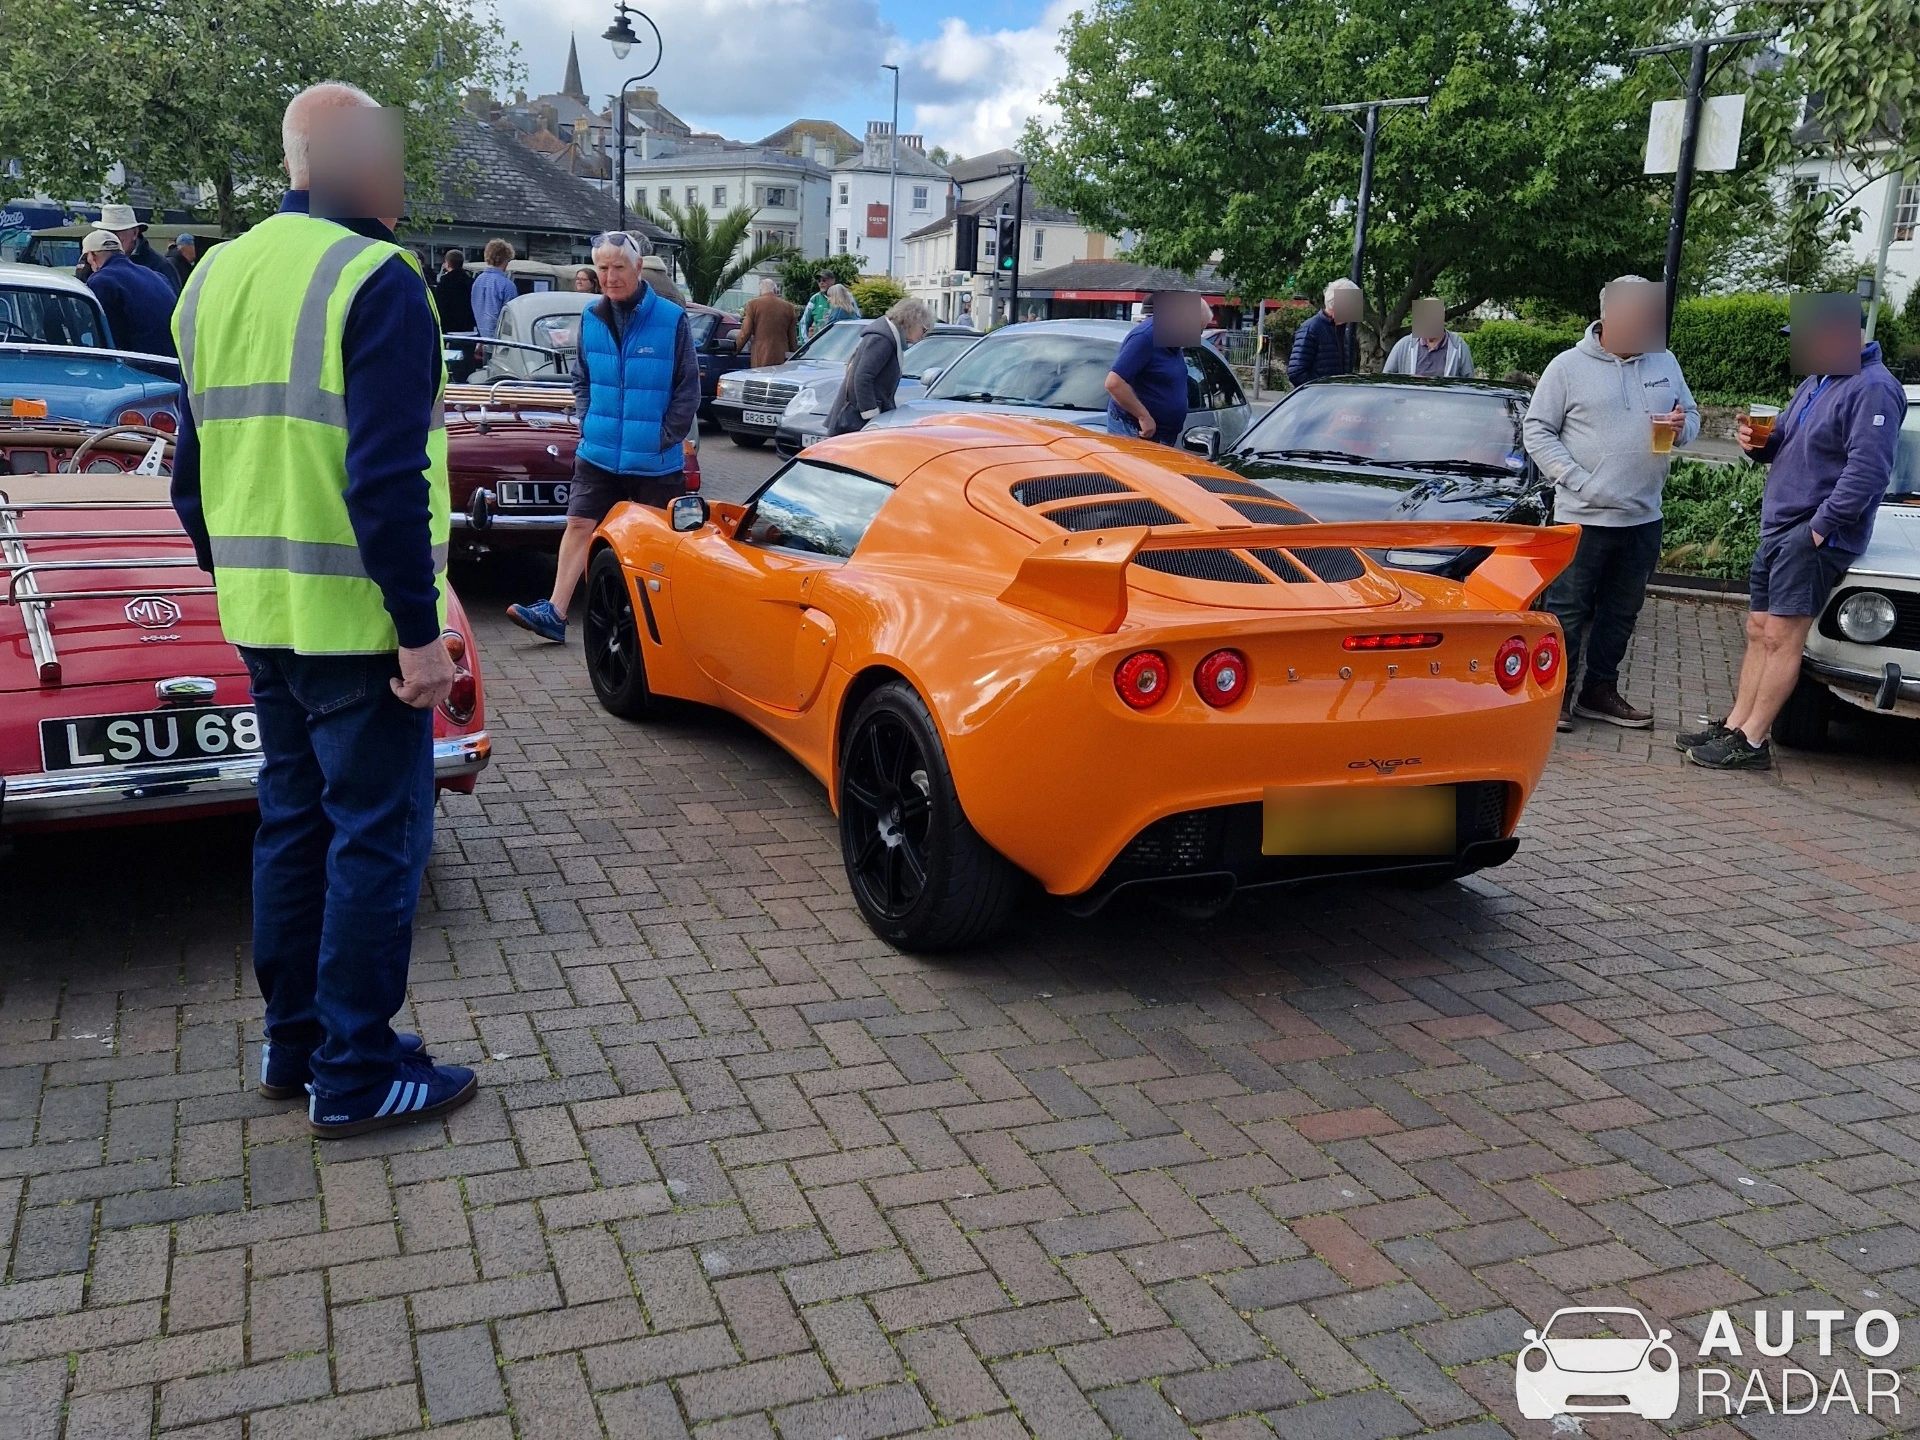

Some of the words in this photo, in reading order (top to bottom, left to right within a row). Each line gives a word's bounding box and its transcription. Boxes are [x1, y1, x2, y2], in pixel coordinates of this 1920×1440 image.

[744, 413, 764, 423] G826
[502, 483, 550, 504] LLL
[132, 600, 176, 625] MG
[1288, 659, 1479, 681] LOTUS
[66, 717, 179, 765] LSU
[195, 712, 262, 753] 68
